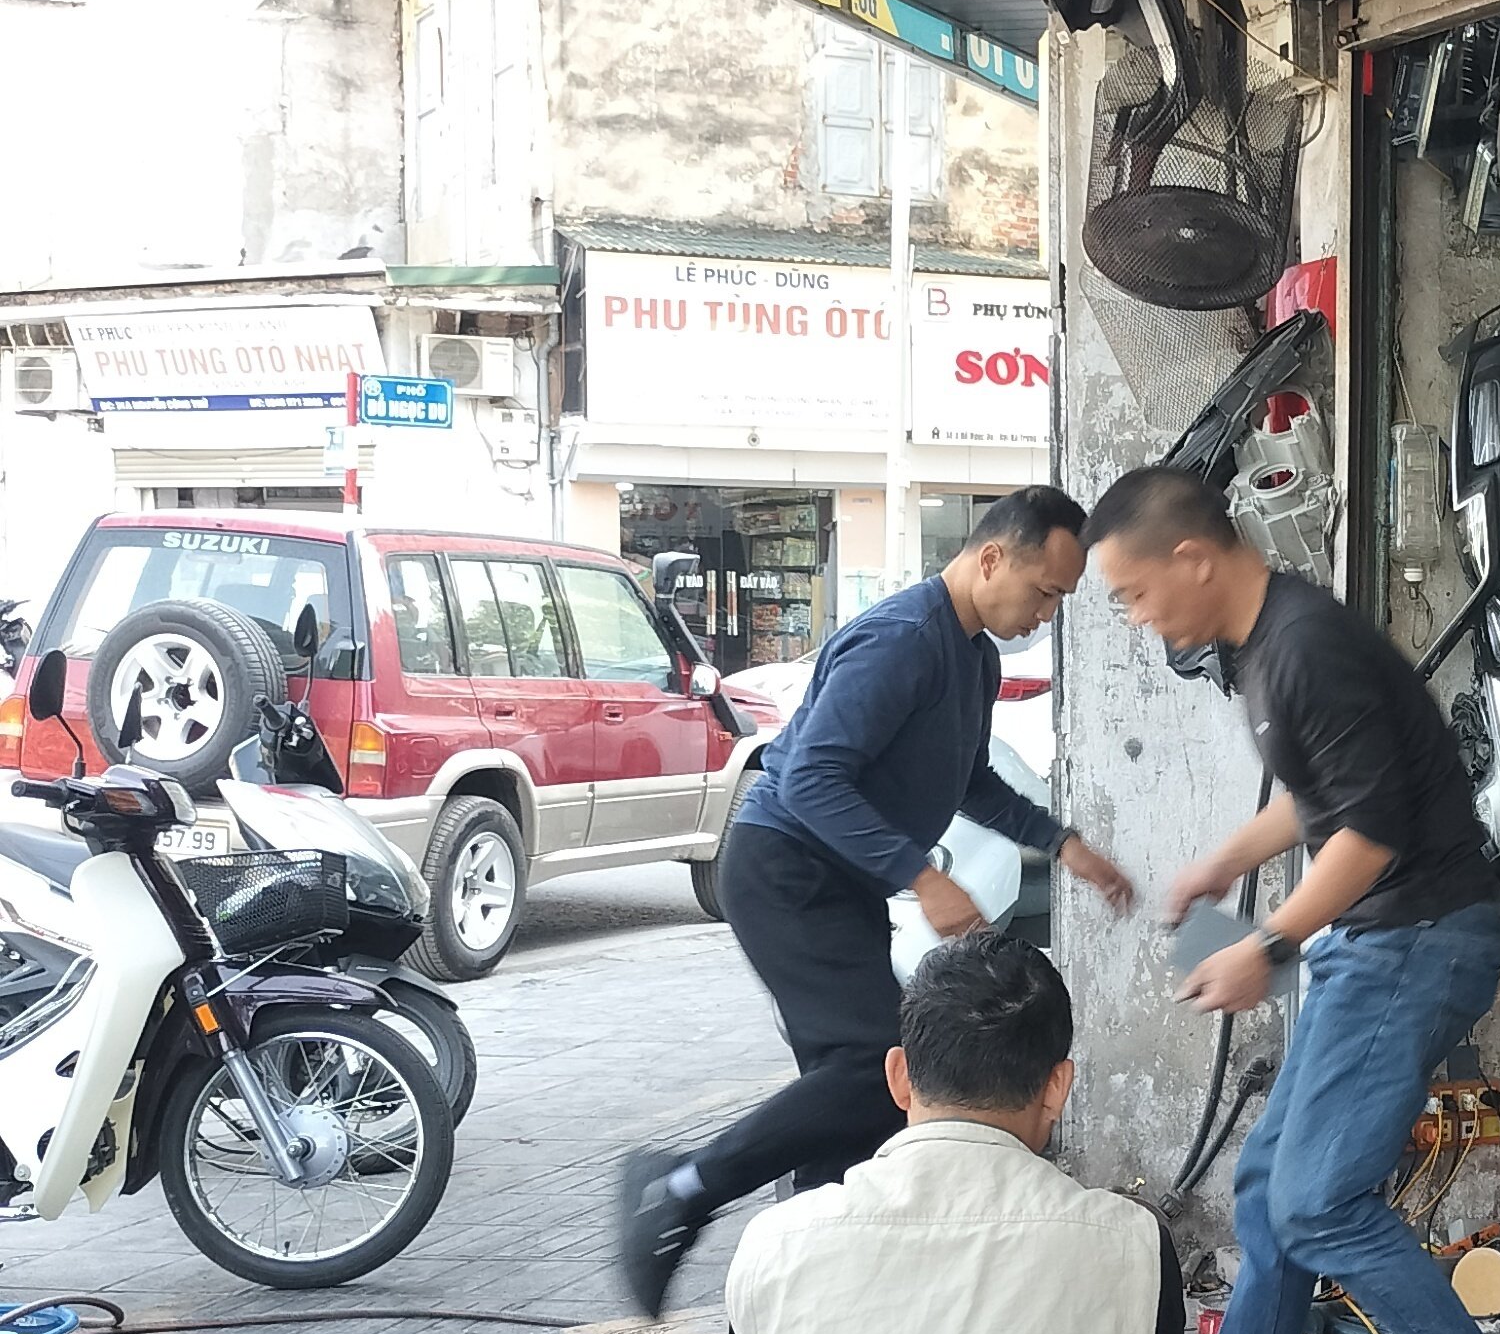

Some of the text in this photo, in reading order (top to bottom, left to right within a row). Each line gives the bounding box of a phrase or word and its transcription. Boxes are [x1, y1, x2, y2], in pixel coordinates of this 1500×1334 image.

[676, 261, 697, 282] LÊ
[704, 264, 757, 286] PHÚC
[775, 267, 830, 290] DŨNG
[604, 294, 688, 337] PHỤ
[703, 292, 808, 336] TÙNG
[973, 302, 1008, 321] PHỤ
[955, 347, 1050, 388] SƠN
[396, 383, 427, 397] PHỐ
[388, 399, 426, 423] NGỌC
[162, 531, 271, 556] SUZUKI
[155, 831, 216, 851] 57.99
